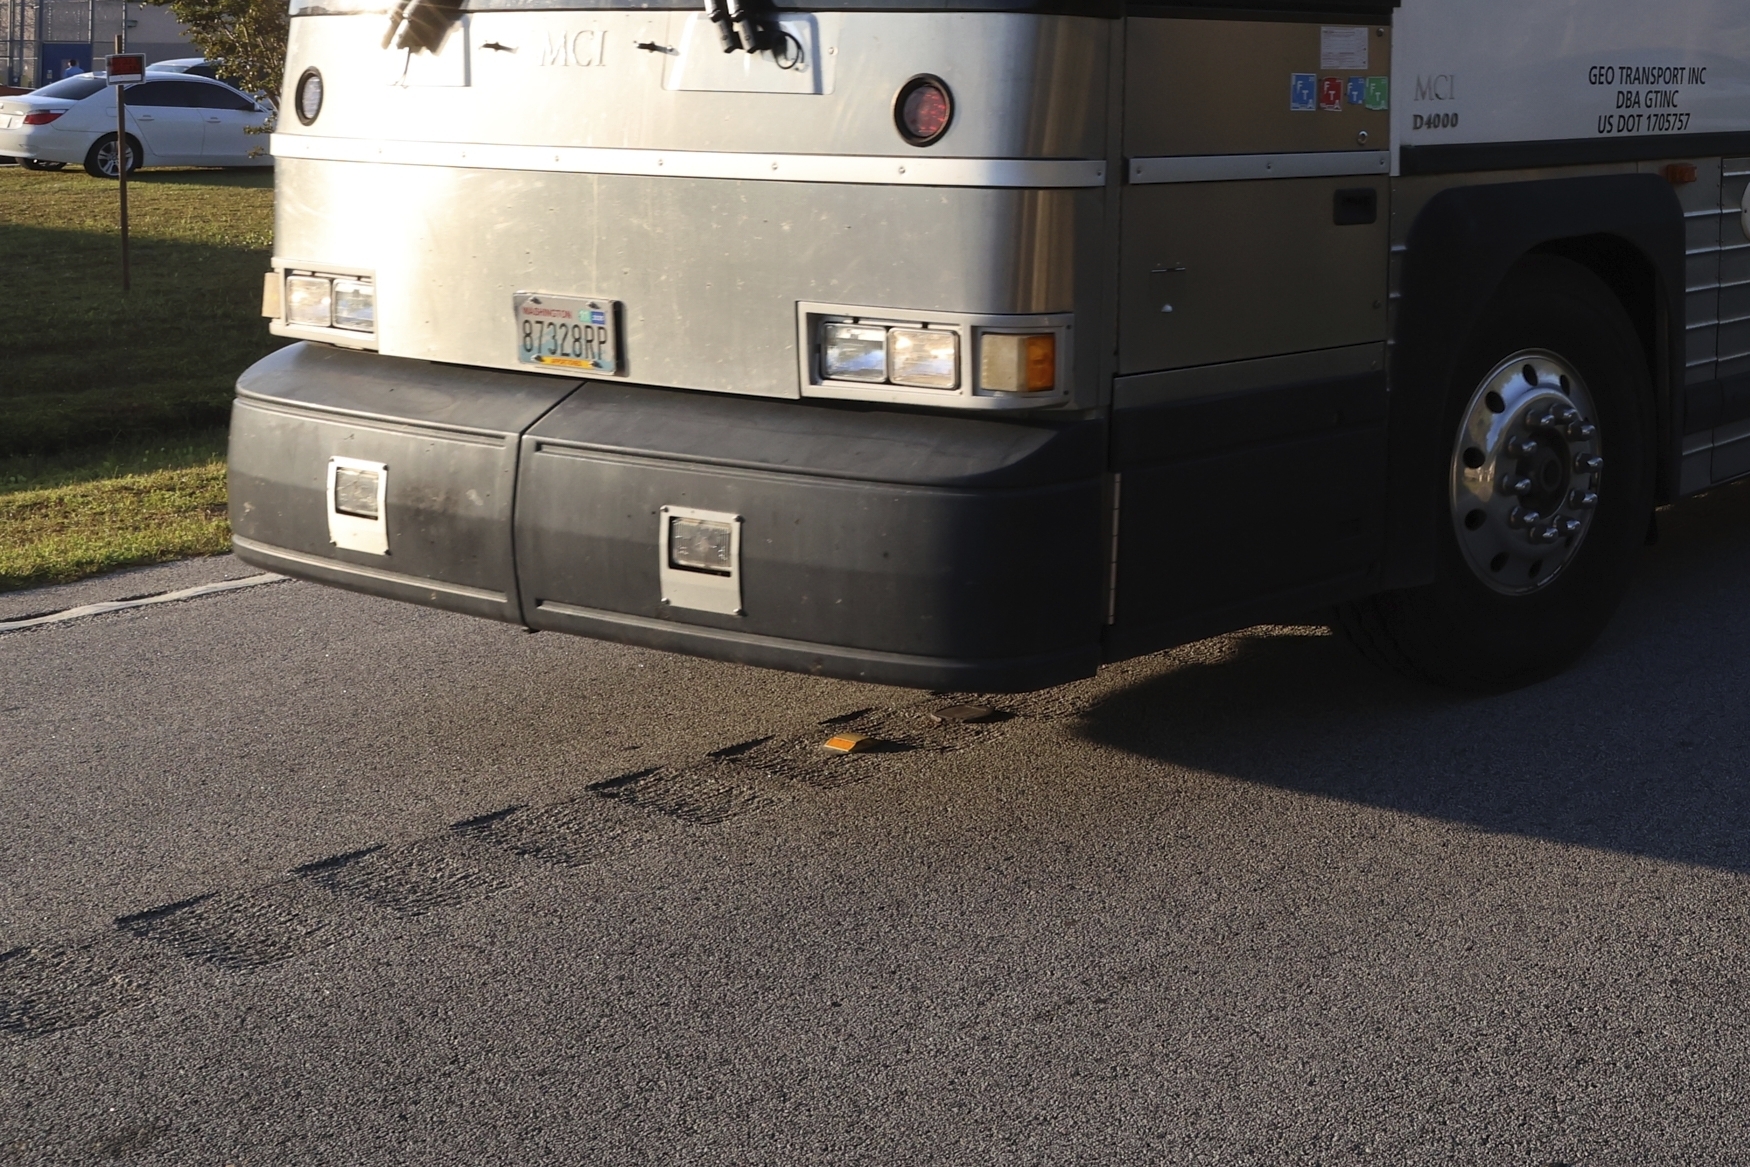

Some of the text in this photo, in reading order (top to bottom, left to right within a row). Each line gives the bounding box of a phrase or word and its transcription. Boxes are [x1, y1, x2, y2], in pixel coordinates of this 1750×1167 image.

[540, 30, 608, 67] MCI
[1588, 66, 1707, 85] GEO TRANSPORT INC
[1414, 74, 1456, 102] MCI
[1616, 90, 1679, 109] DBA GTINC
[1412, 113, 1459, 130] D4000
[1597, 113, 1691, 134] US DOT 1705757
[522, 319, 608, 361] 87328RP
